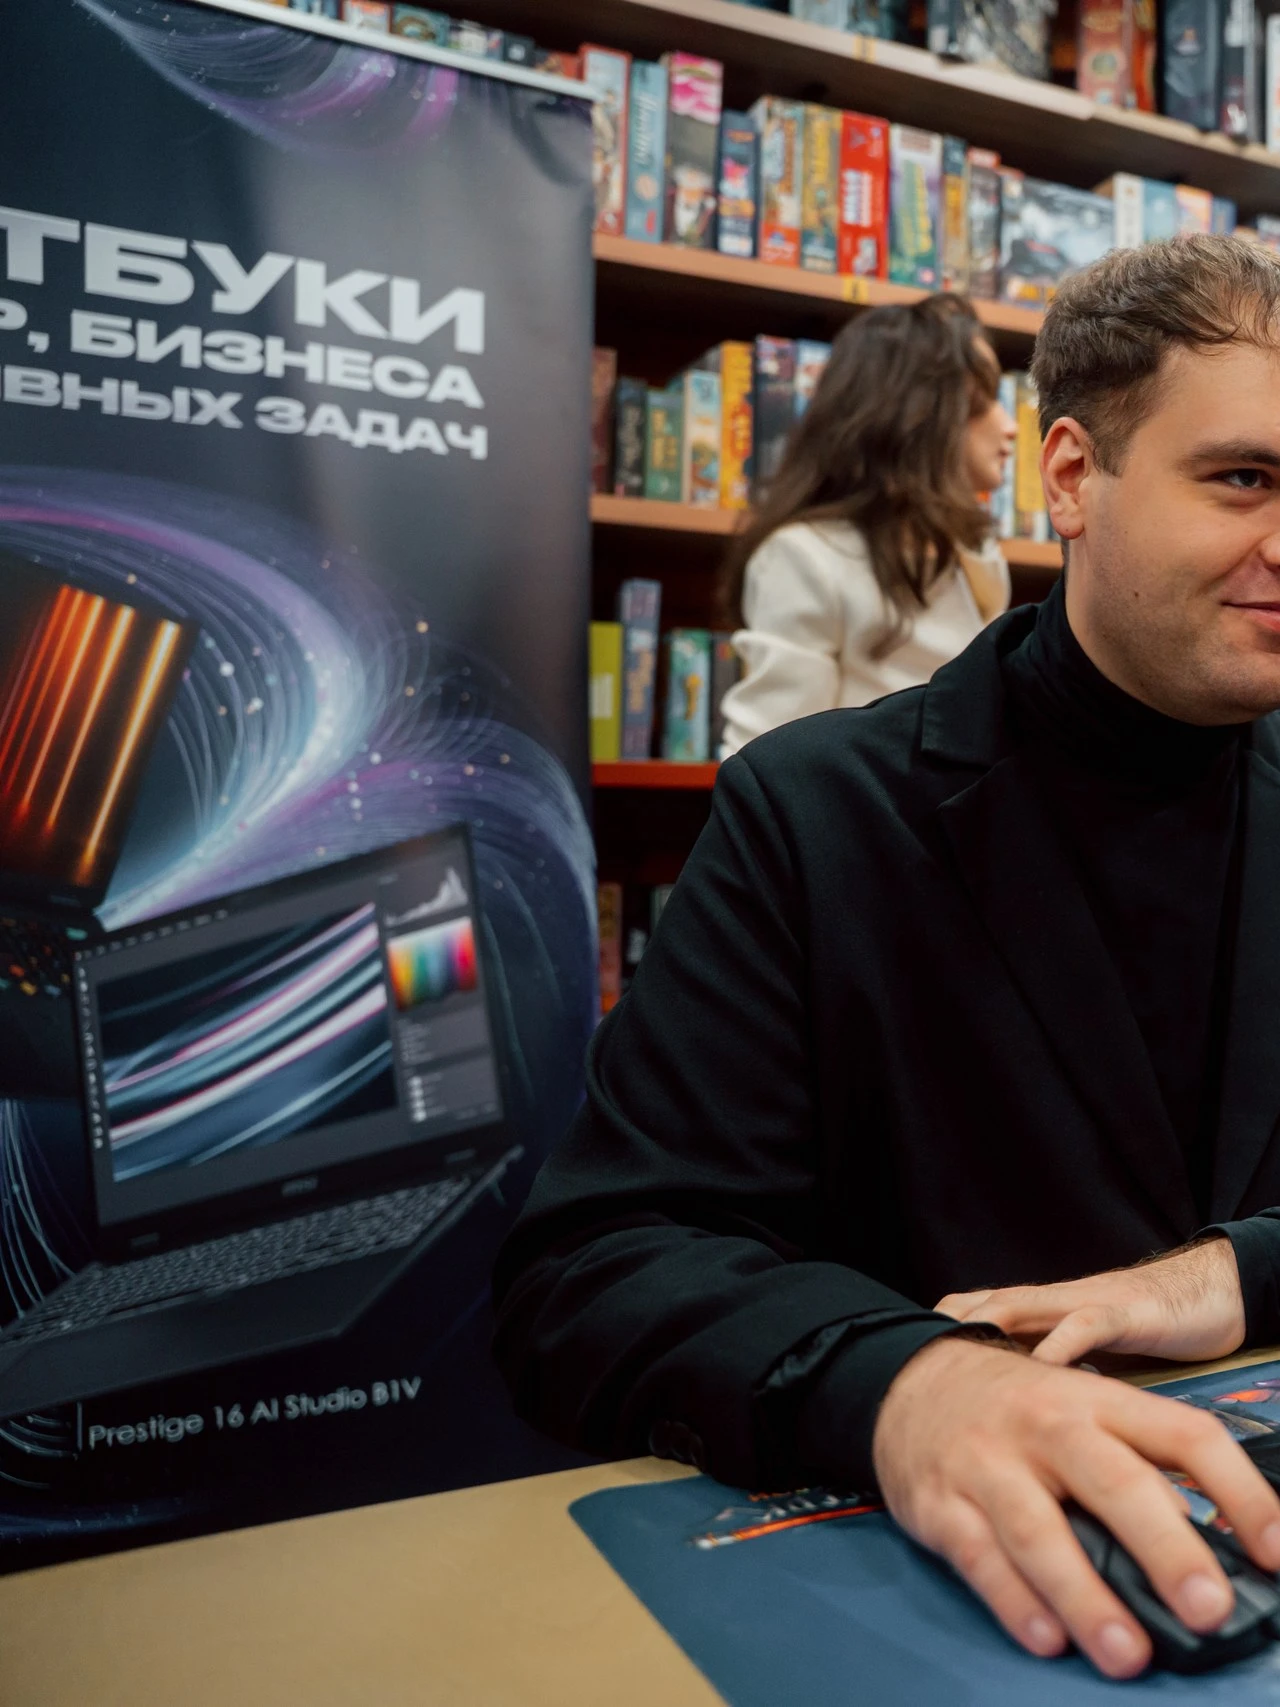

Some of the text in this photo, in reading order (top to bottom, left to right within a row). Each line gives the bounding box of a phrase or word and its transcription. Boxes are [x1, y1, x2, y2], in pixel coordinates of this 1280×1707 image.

[0, 206, 485, 355] ТБУКИ
[70, 309, 485, 409] БИЗНЕСА
[0, 364, 488, 460] ВНЫХ ЗАДАЧ
[88, 1414, 204, 1450] Prestige
[214, 1403, 245, 1430] 16
[251, 1398, 279, 1425] AI
[284, 1386, 369, 1420] Studio
